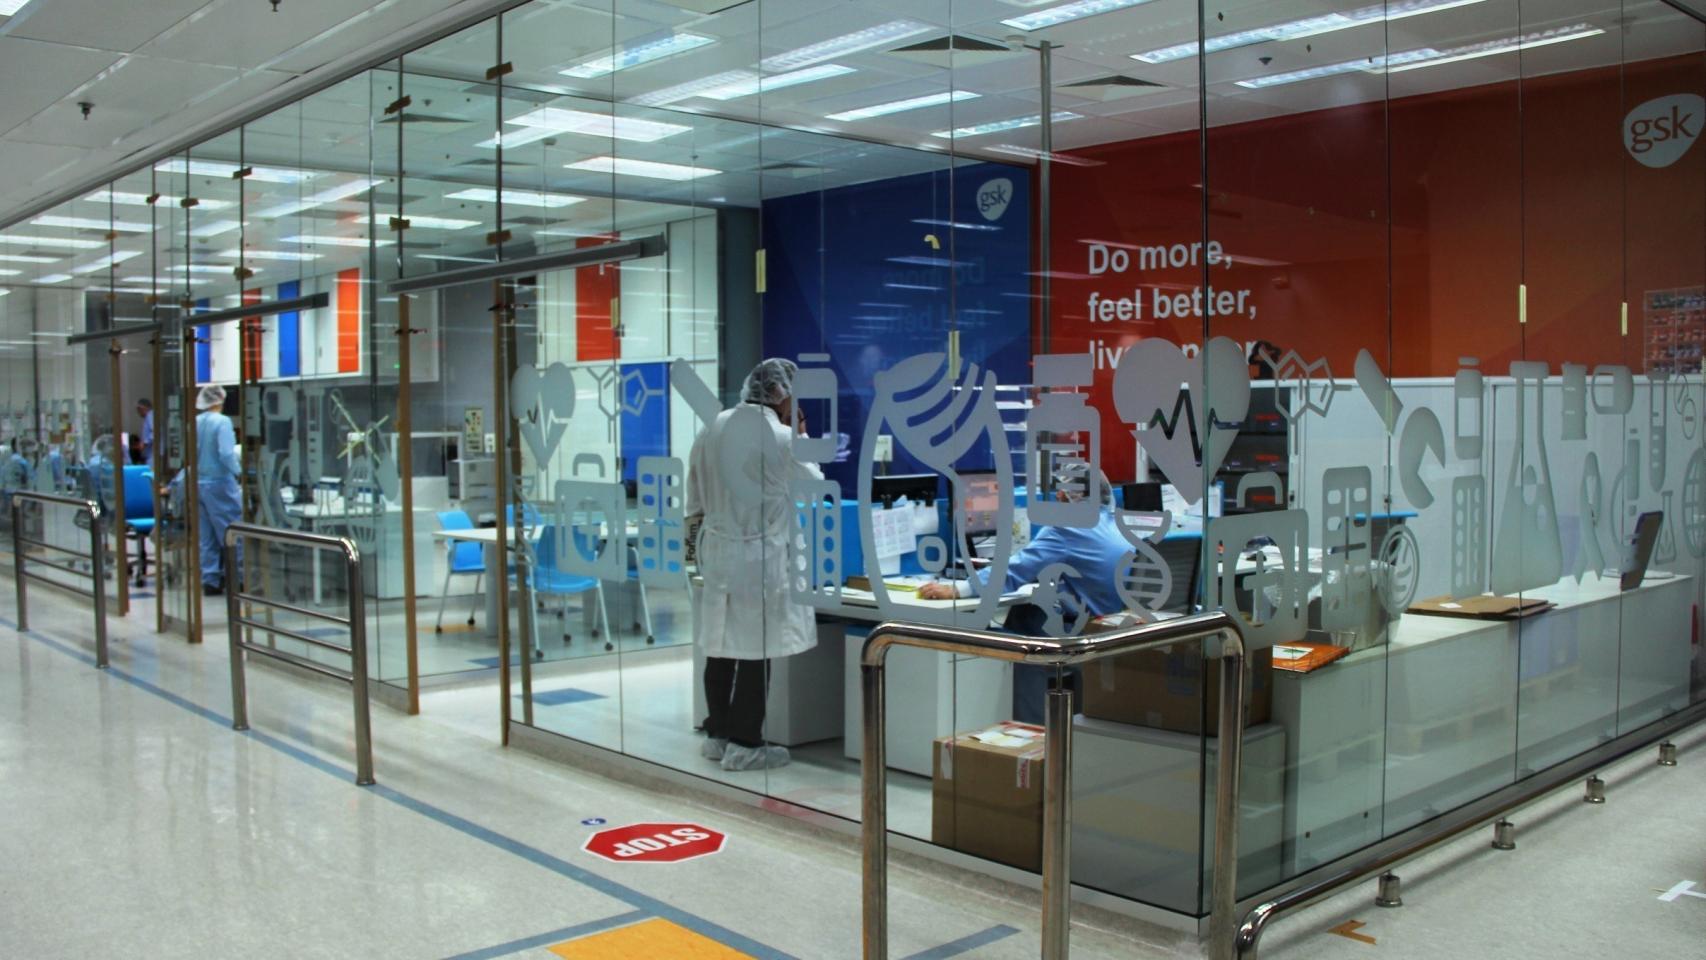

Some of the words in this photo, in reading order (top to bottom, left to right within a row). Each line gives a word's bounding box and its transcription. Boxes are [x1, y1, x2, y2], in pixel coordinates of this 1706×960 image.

[1630, 104, 1695, 154] gsk
[980, 185, 1008, 212] gsk
[1088, 244, 1130, 275] Do
[1140, 239, 1232, 270] more,
[1088, 288, 1142, 322] feel
[1152, 285, 1257, 320] better,
[1089, 339, 1131, 370] liv
[612, 827, 711, 858] STOP
